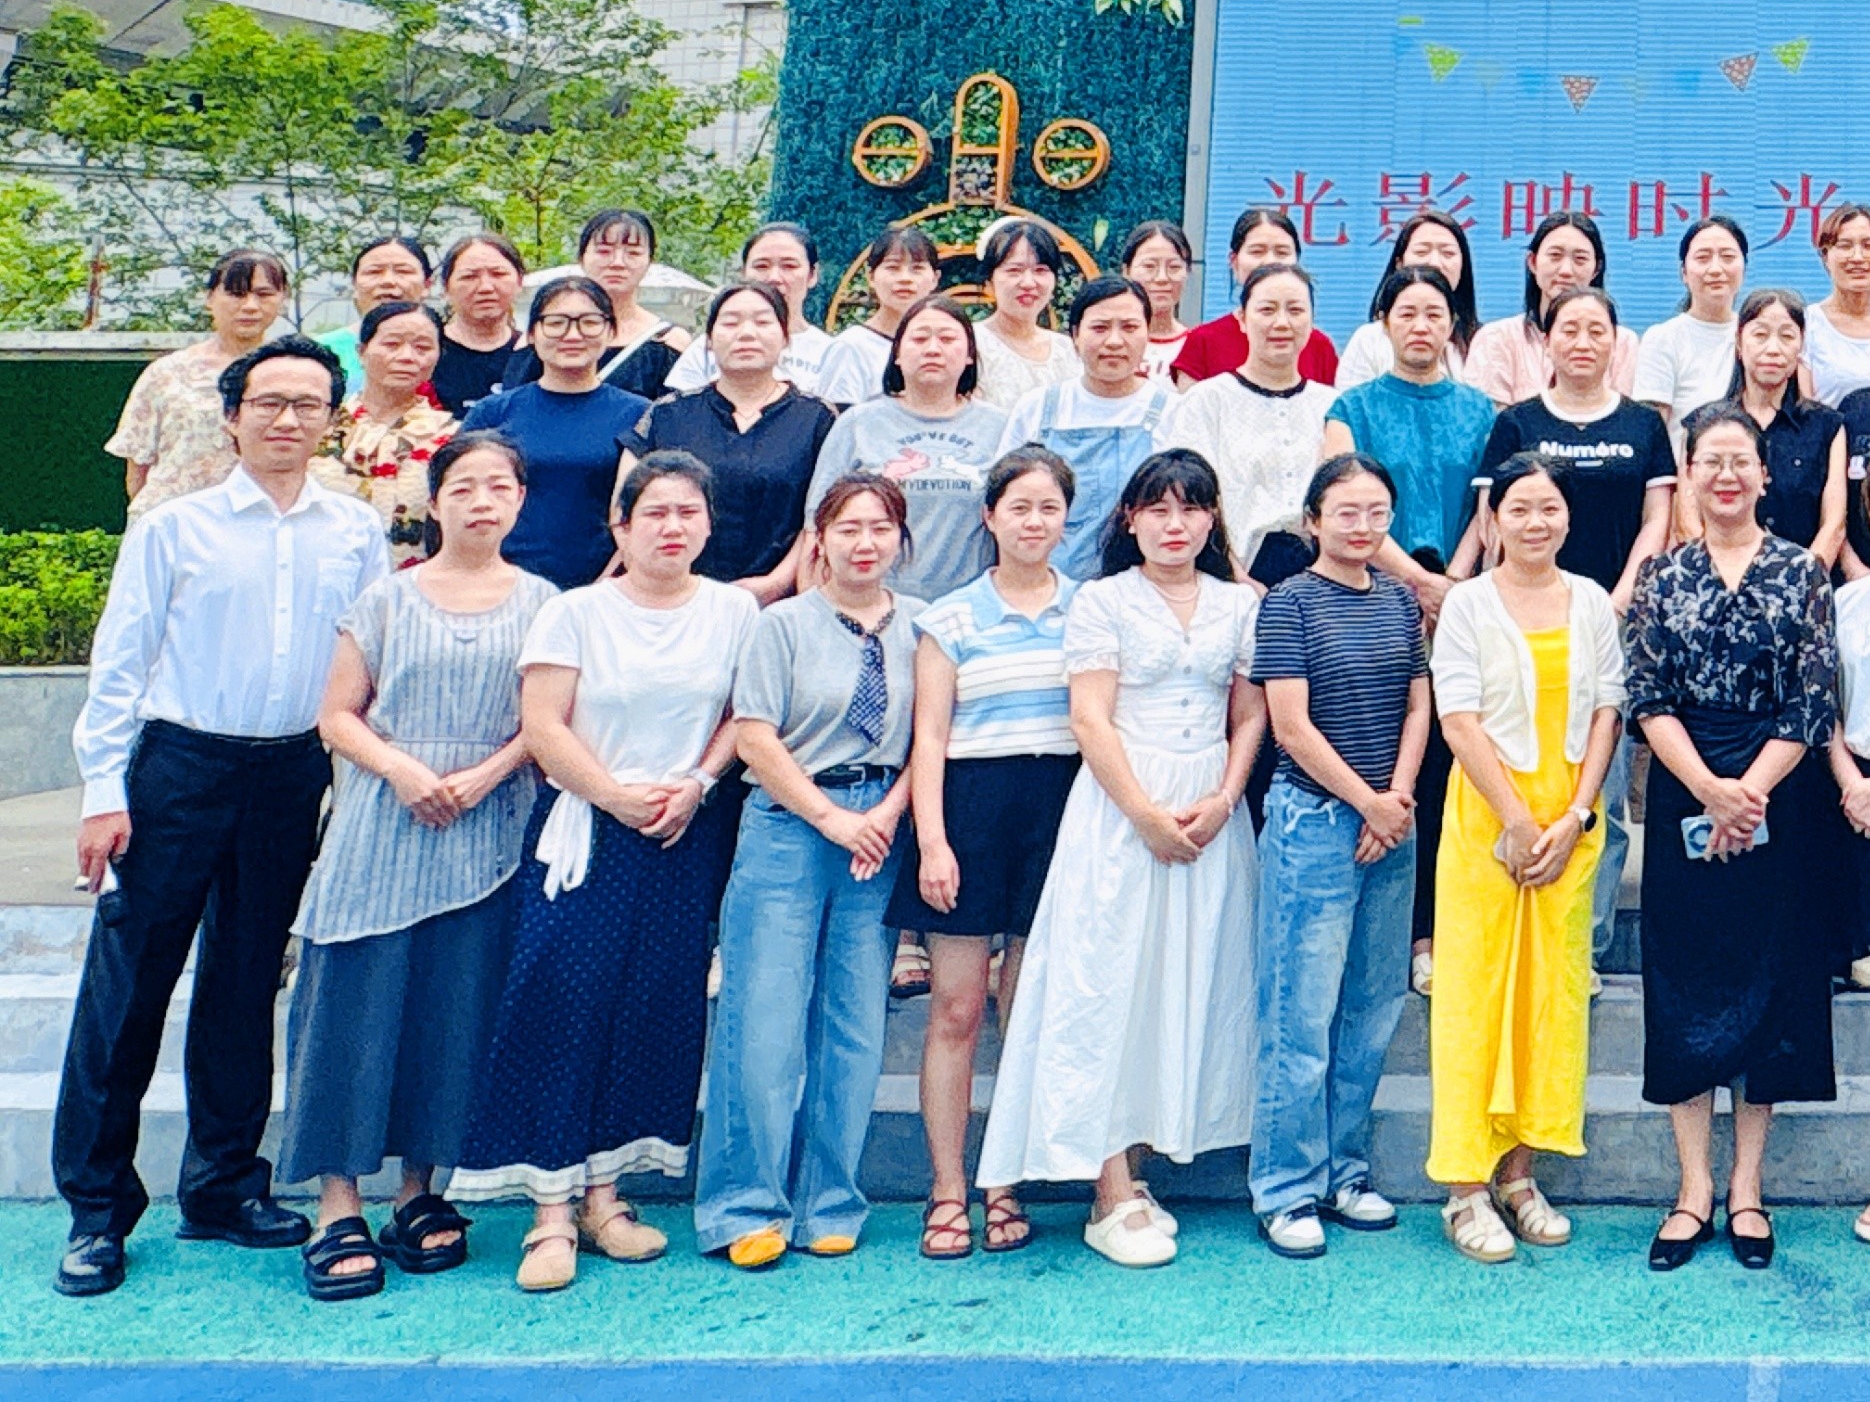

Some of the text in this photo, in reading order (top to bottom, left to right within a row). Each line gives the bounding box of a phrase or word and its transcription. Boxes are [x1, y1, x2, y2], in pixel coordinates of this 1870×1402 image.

[1247, 170, 1840, 251] 光影映时光
